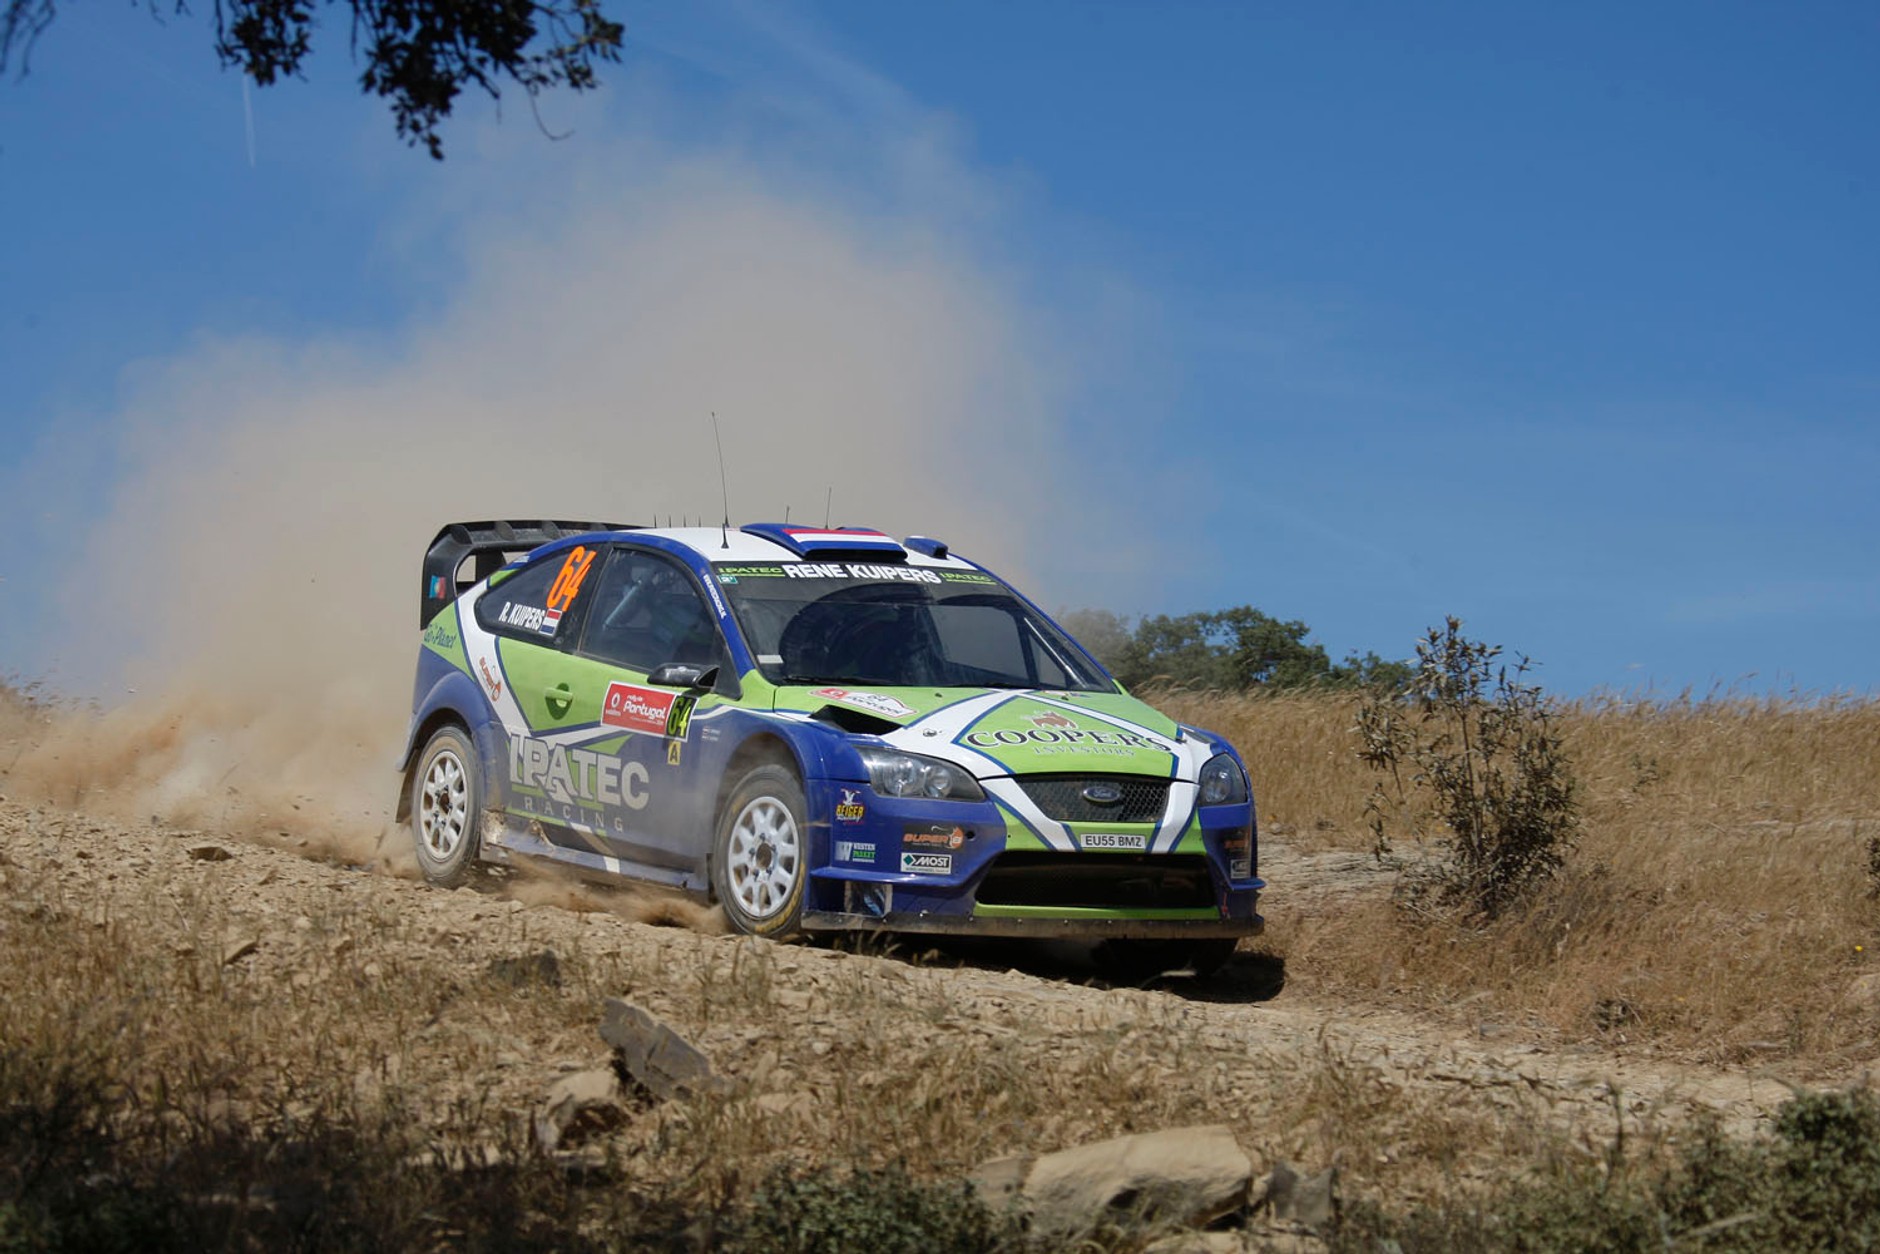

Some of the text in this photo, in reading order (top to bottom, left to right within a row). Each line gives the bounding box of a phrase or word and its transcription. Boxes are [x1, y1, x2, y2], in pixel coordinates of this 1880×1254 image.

[546, 546, 597, 612] 64
[782, 564, 942, 584] RENE KUIPERS
[508, 603, 546, 631] KUIPERS
[623, 701, 666, 720] Portugal
[667, 696, 692, 738] 64
[966, 729, 1173, 754] COOPERS
[669, 743, 679, 763] A
[1033, 747, 1136, 757] INVESTORS
[509, 733, 650, 811] IPATEC
[523, 796, 624, 833] RACING
[903, 833, 949, 844] SUPER
[1085, 835, 1142, 848] EU55 BMZ
[915, 856, 948, 868] MOST
